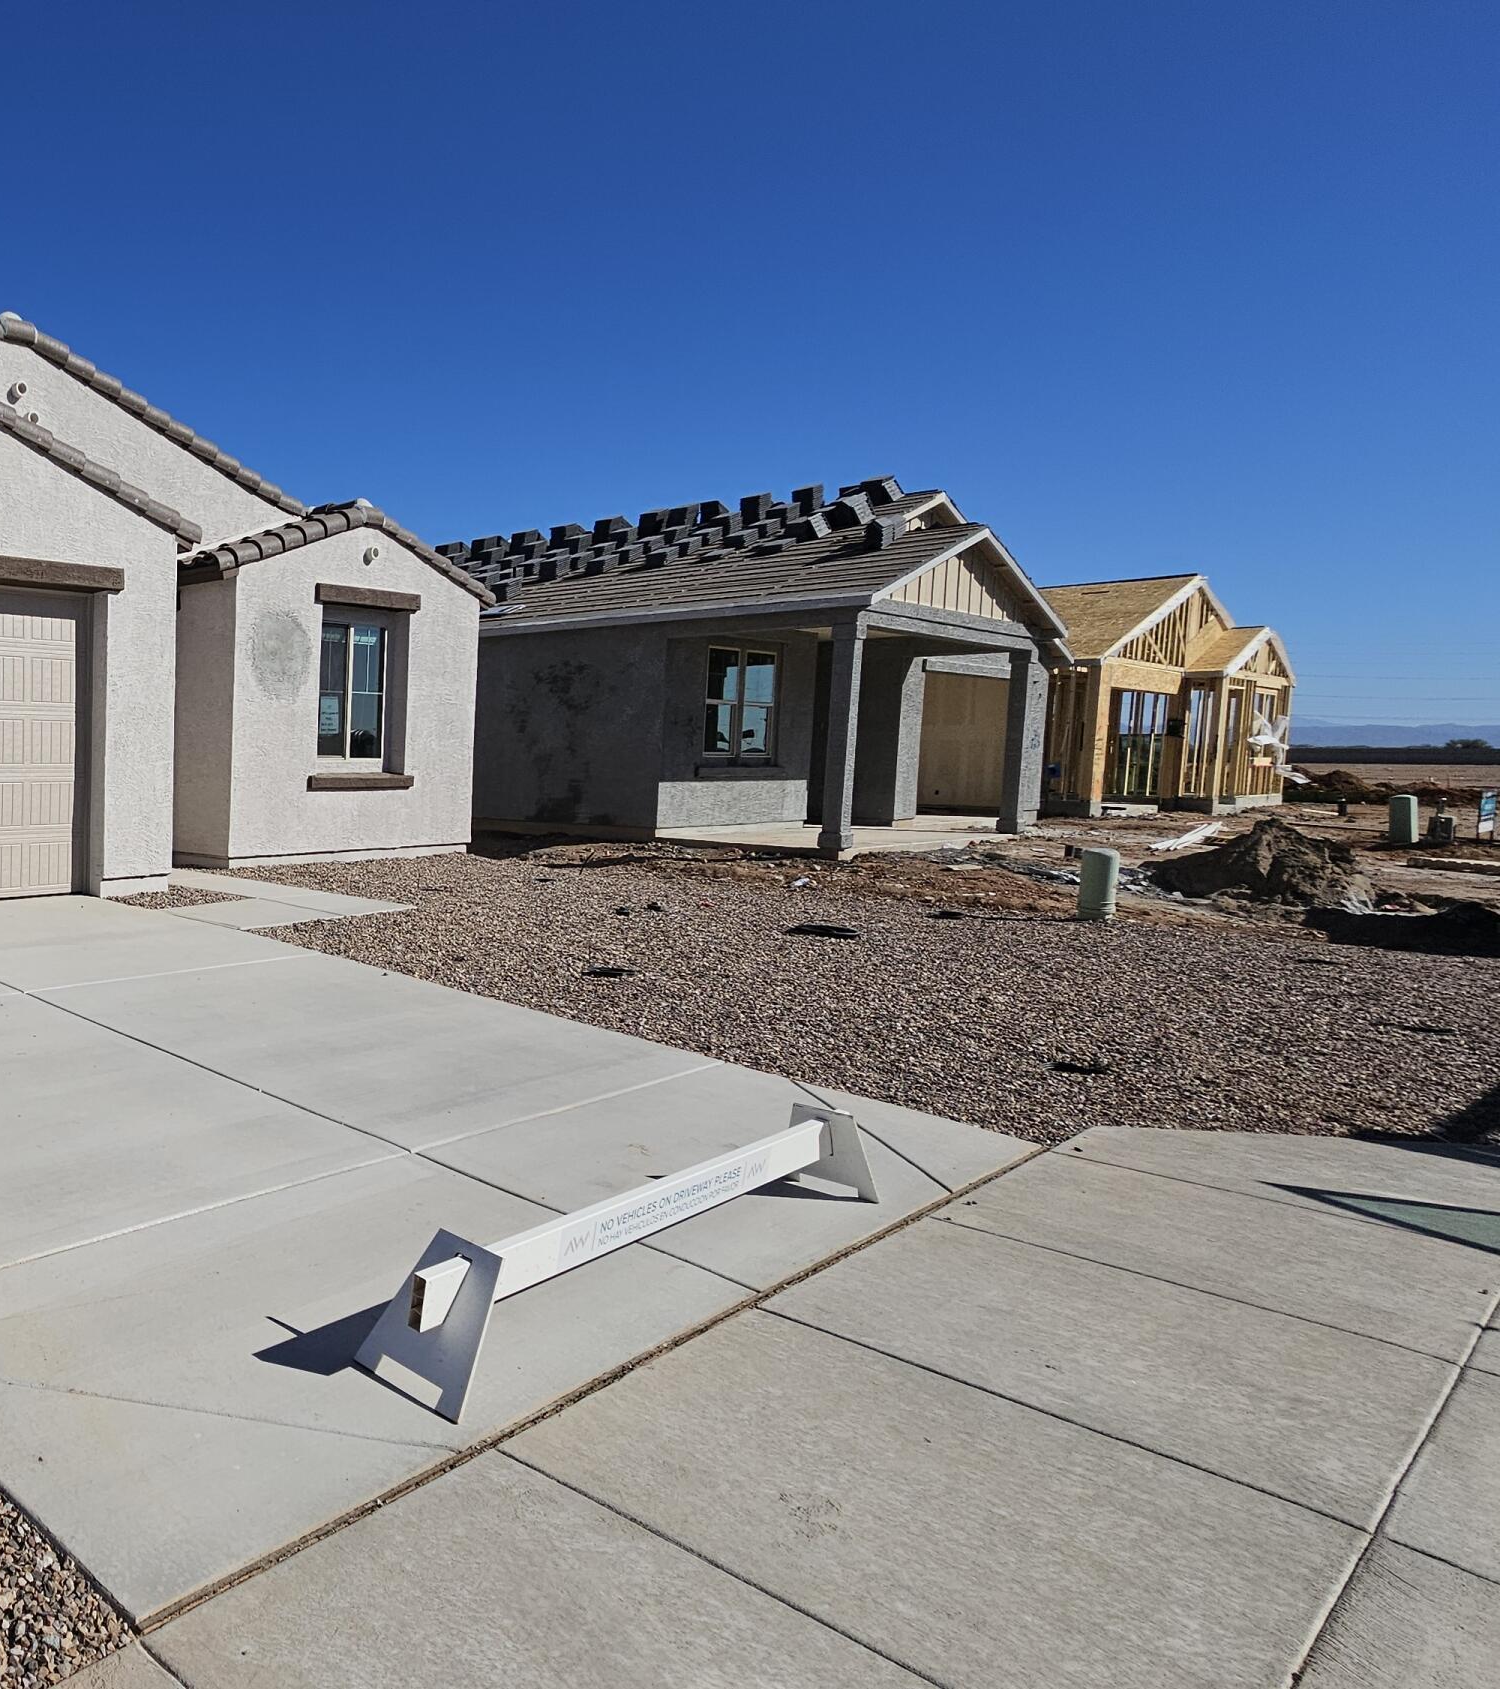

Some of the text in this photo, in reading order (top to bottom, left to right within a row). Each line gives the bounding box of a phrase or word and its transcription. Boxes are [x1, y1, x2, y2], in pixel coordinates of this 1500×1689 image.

[599, 1166, 742, 1234] NO VEHICLES ON DRIVEWAY PLEASE
